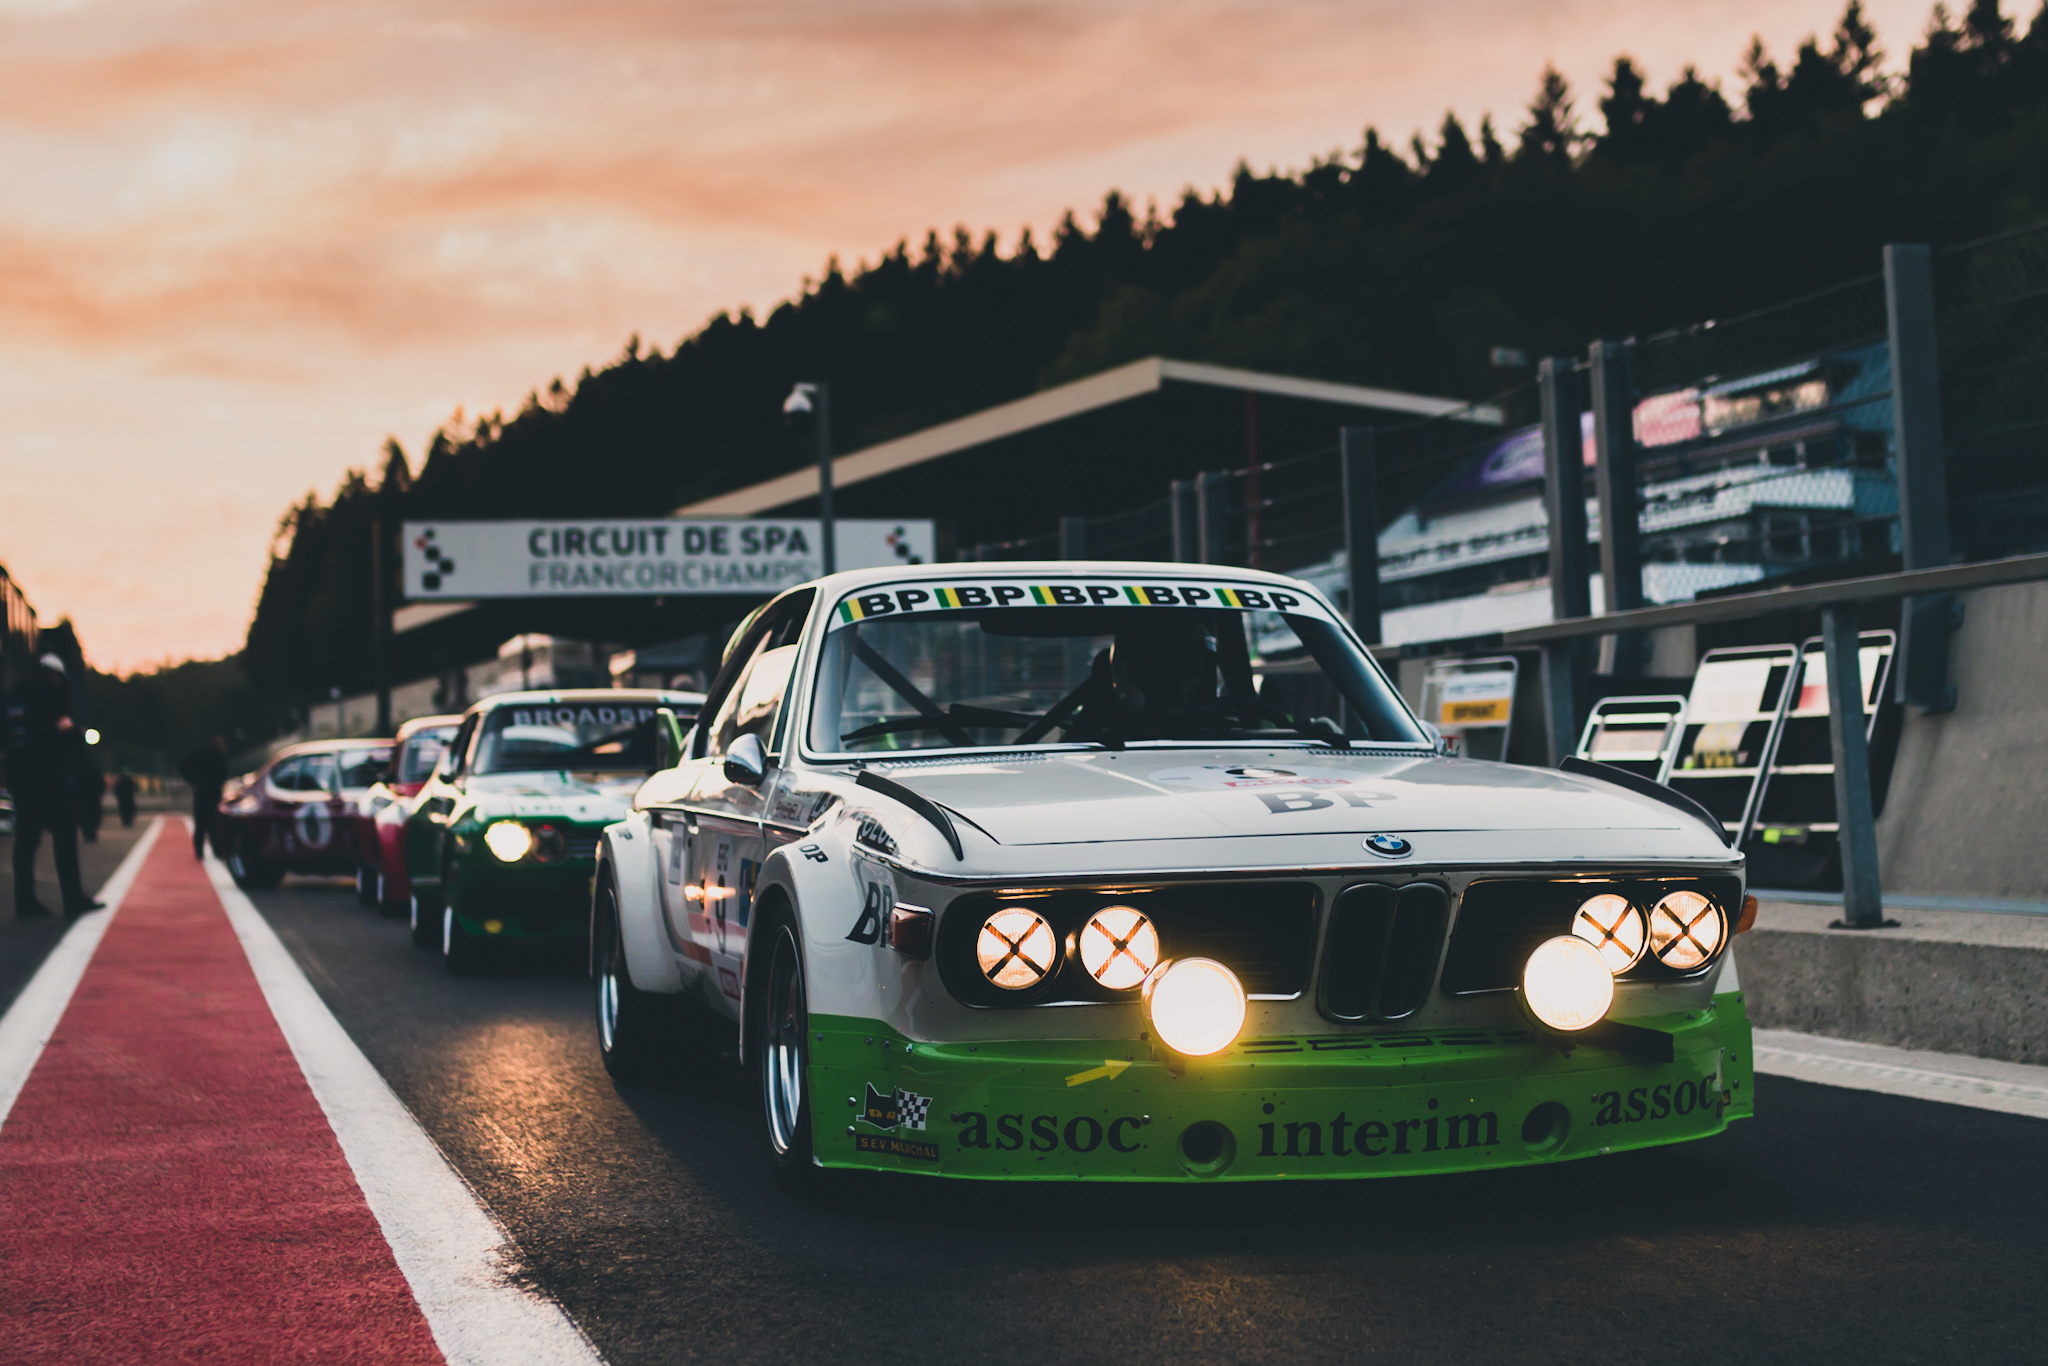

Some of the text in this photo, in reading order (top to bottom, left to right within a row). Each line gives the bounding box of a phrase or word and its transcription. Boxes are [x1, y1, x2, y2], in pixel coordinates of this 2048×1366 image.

[528, 525, 810, 557] CIRCUIT DE SPA
[529, 559, 812, 589] FRANCORCHAMPS
[857, 586, 1300, 619] BP BP BP BP BP
[1255, 790, 1399, 815] BP
[844, 881, 893, 949] BP
[958, 1072, 1717, 1158] assoc interim assoc
[890, 1140, 937, 1158] MARCHAL
